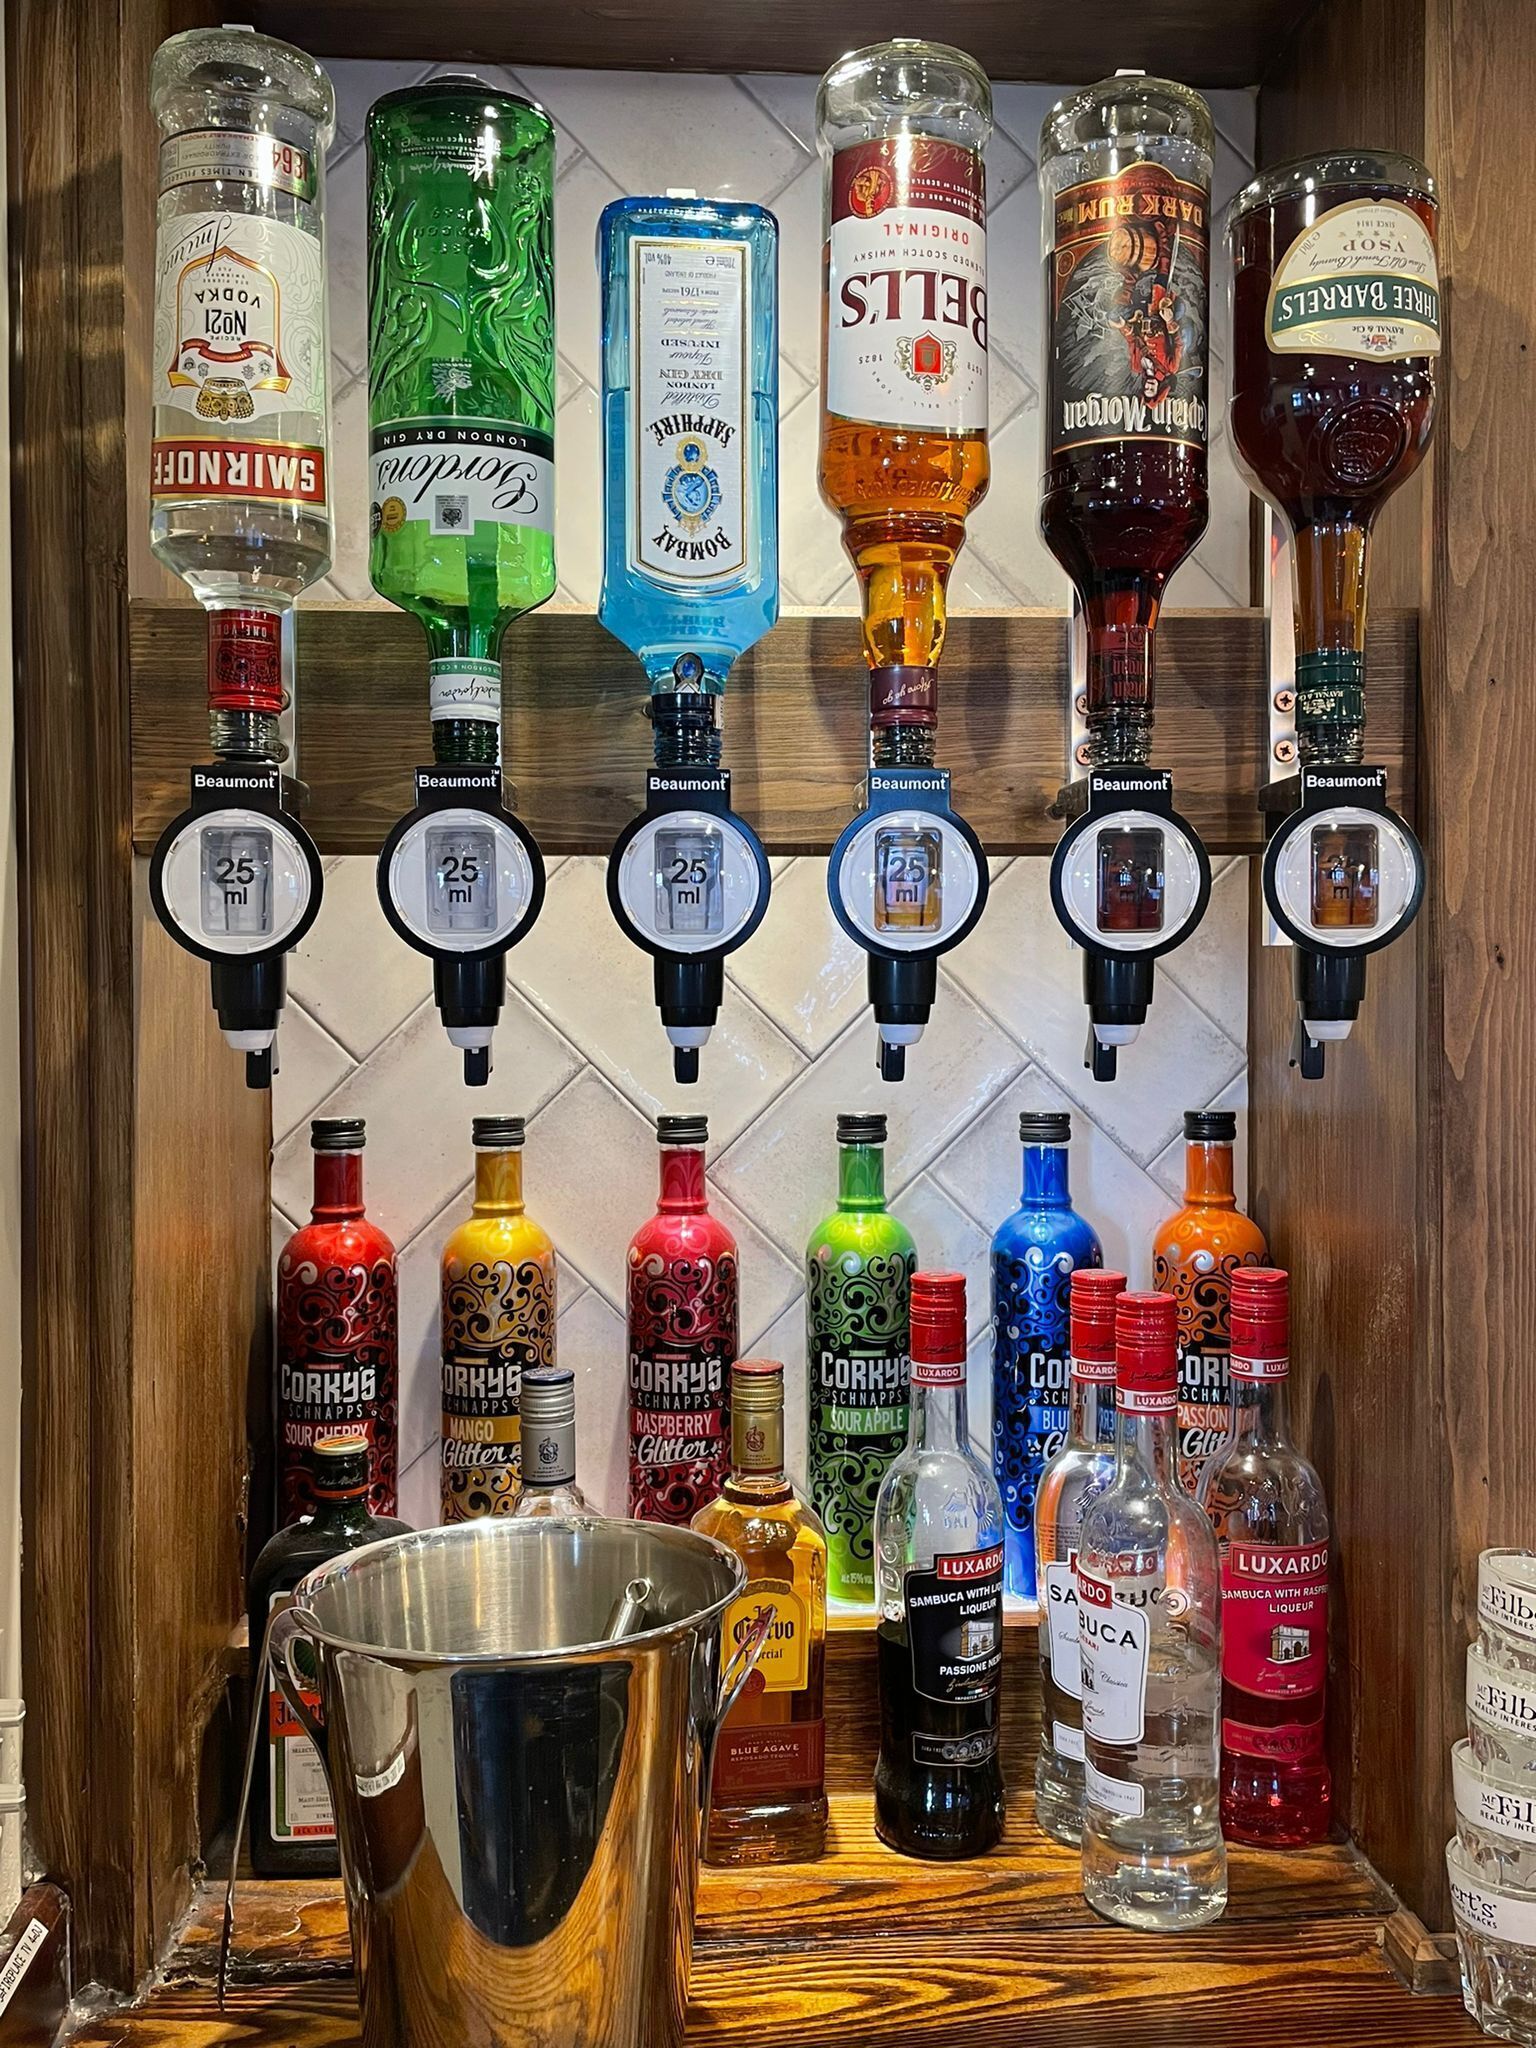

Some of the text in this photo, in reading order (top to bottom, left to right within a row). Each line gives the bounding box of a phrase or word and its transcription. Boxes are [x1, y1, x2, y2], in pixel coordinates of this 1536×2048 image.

[200, 167, 231, 178] TIMES
[1077, 194, 1138, 224] RUM
[1141, 194, 1203, 227] DARK
[1376, 220, 1396, 229] SINCE
[883, 223, 969, 246] ORIGINAL
[902, 249, 948, 260] SCOTCH
[1342, 238, 1406, 254] VSOP
[853, 249, 896, 263] WHISKY
[1308, 254, 1353, 271] Brandy
[1354, 253, 1391, 270] French
[1390, 256, 1409, 270] Old
[194, 288, 261, 309] VODKA
[680, 286, 700, 297] 1761
[840, 271, 987, 353] BELL'S
[1281, 280, 1438, 326] THREE BARRELS
[1376, 325, 1404, 335] RAYNAL
[660, 338, 720, 349] INFUSED
[668, 350, 713, 366] Vapour
[858, 353, 883, 365] 1825
[658, 368, 723, 381] DRY GIN
[666, 381, 715, 390] LONDON
[660, 390, 722, 410] Distilled
[1063, 393, 1151, 432] Morgan
[383, 430, 527, 448] LONDON DRY GIN
[648, 413, 737, 450] SAPPHIRE
[154, 451, 315, 492] SMIRNOFF
[377, 453, 538, 515] Gordon's
[651, 524, 733, 561] BOMBAY
[882, 690, 894, 705] go
[1314, 690, 1344, 698] RAYNAL
[216, 858, 255, 884] 25
[442, 856, 478, 883] 25
[671, 858, 707, 884] 25
[889, 856, 925, 883] 25
[224, 887, 248, 905] ml
[449, 885, 473, 903] ml
[677, 887, 700, 904] ml
[895, 884, 918, 903] ml
[444, 1361, 521, 1399] ORKY'S
[918, 1367, 959, 1377] LUXARDO
[637, 1393, 710, 1410] SCHNAPPS
[832, 1390, 902, 1406] SCHNAPPS
[1136, 1395, 1177, 1406] LUXARDO
[289, 1403, 363, 1420] SCHNAPPS
[830, 1409, 904, 1432] SOUR APPLE
[1178, 1404, 1228, 1428] PASSION
[450, 1419, 494, 1442] MANGO
[636, 1411, 713, 1436] RASPBERRY
[285, 1423, 313, 1447] SOUR
[443, 1438, 508, 1468] Glitter
[638, 1433, 710, 1465] Glitter
[943, 1550, 1004, 1575] LUXARDO
[1239, 1549, 1328, 1575] LUXARDO
[910, 1585, 990, 1608] SAMBUCA WITH
[1222, 1588, 1301, 1599] SAMBUCA WITH
[959, 1597, 997, 1615] LIQUEUR
[1269, 1601, 1315, 1614] LIQUEUR
[1501, 1613, 1535, 1631] INTERES
[939, 1659, 987, 1675] PASSIONE
[730, 1743, 800, 1755] BLUE AGAVE
[1480, 1809, 1511, 1826] REALLY
[1495, 1793, 1536, 1825] Fil
[20, 1942, 32, 1955] TV
